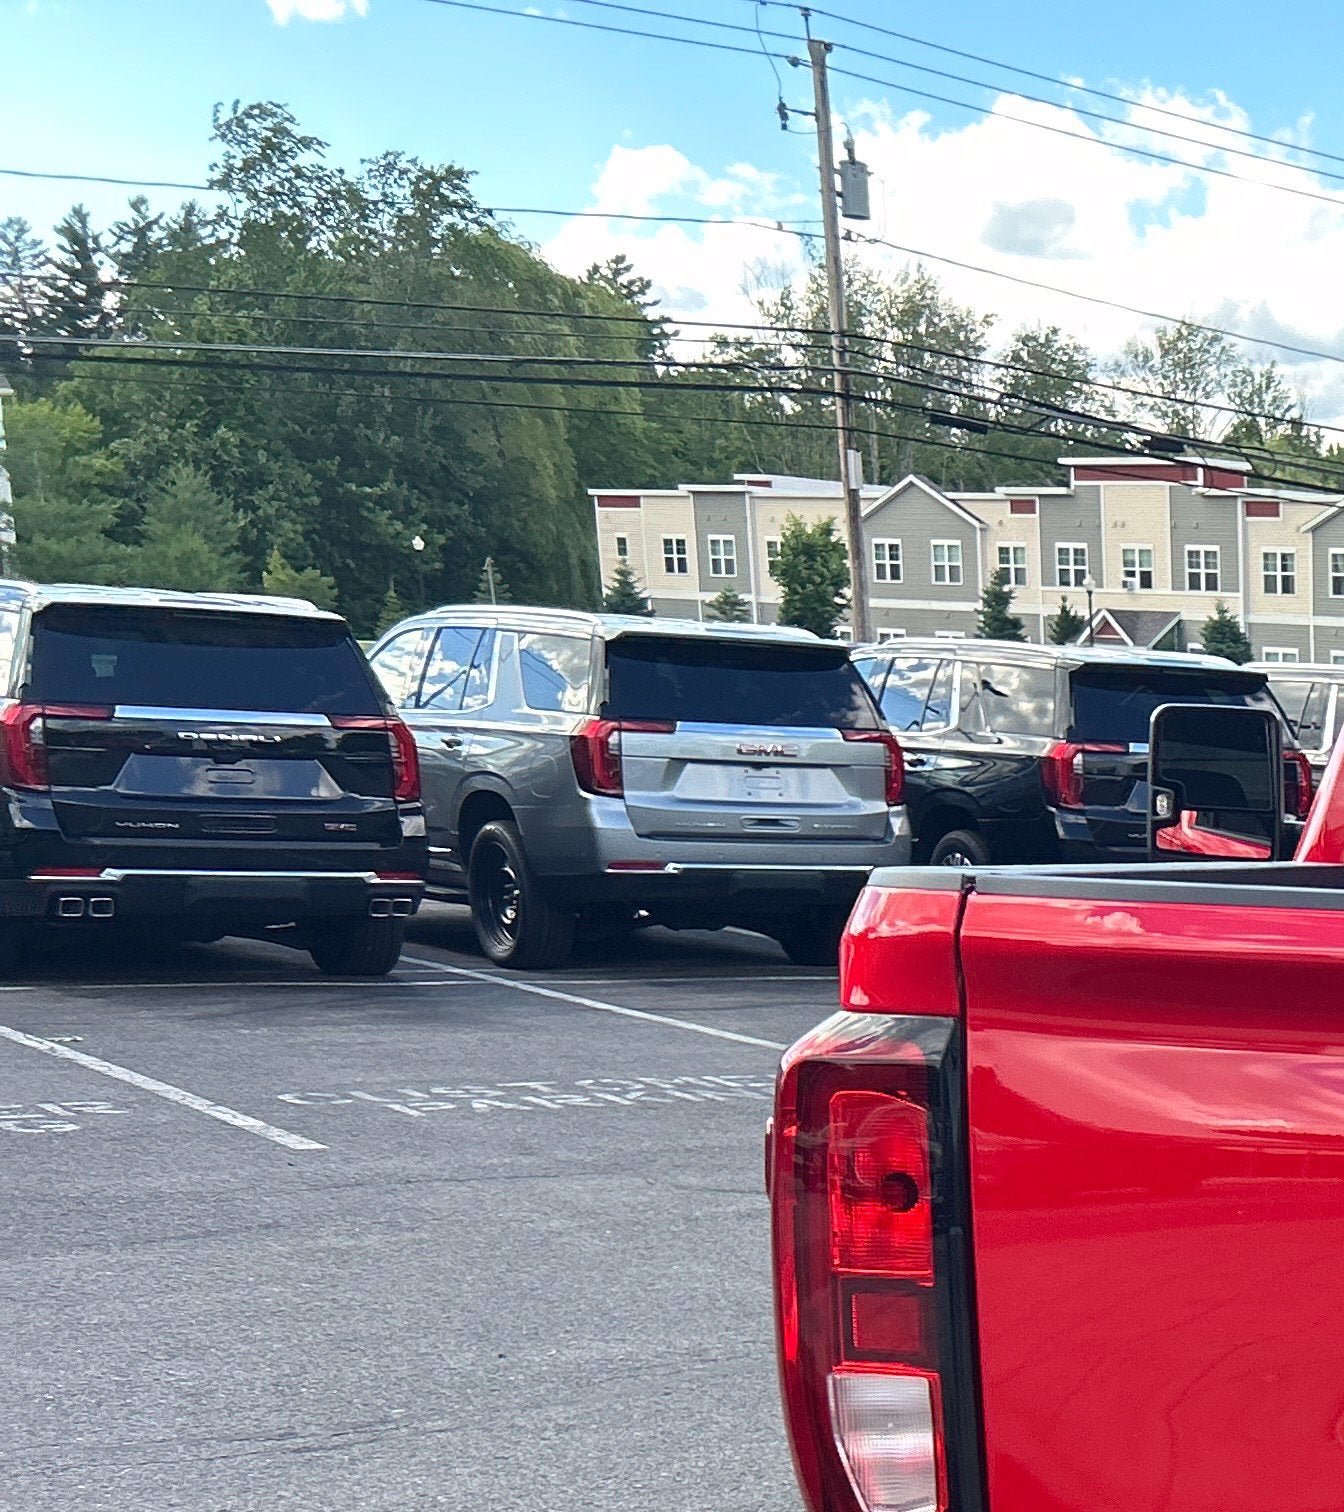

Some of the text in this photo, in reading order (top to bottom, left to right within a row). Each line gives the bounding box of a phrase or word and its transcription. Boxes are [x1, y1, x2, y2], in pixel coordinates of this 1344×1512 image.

[177, 731, 282, 743] DENALI
[736, 743, 799, 758] GMC
[114, 820, 180, 829] YUKON
[276, 1073, 775, 1105] CUSTOME
[384, 1087, 774, 1117] PARKIN
